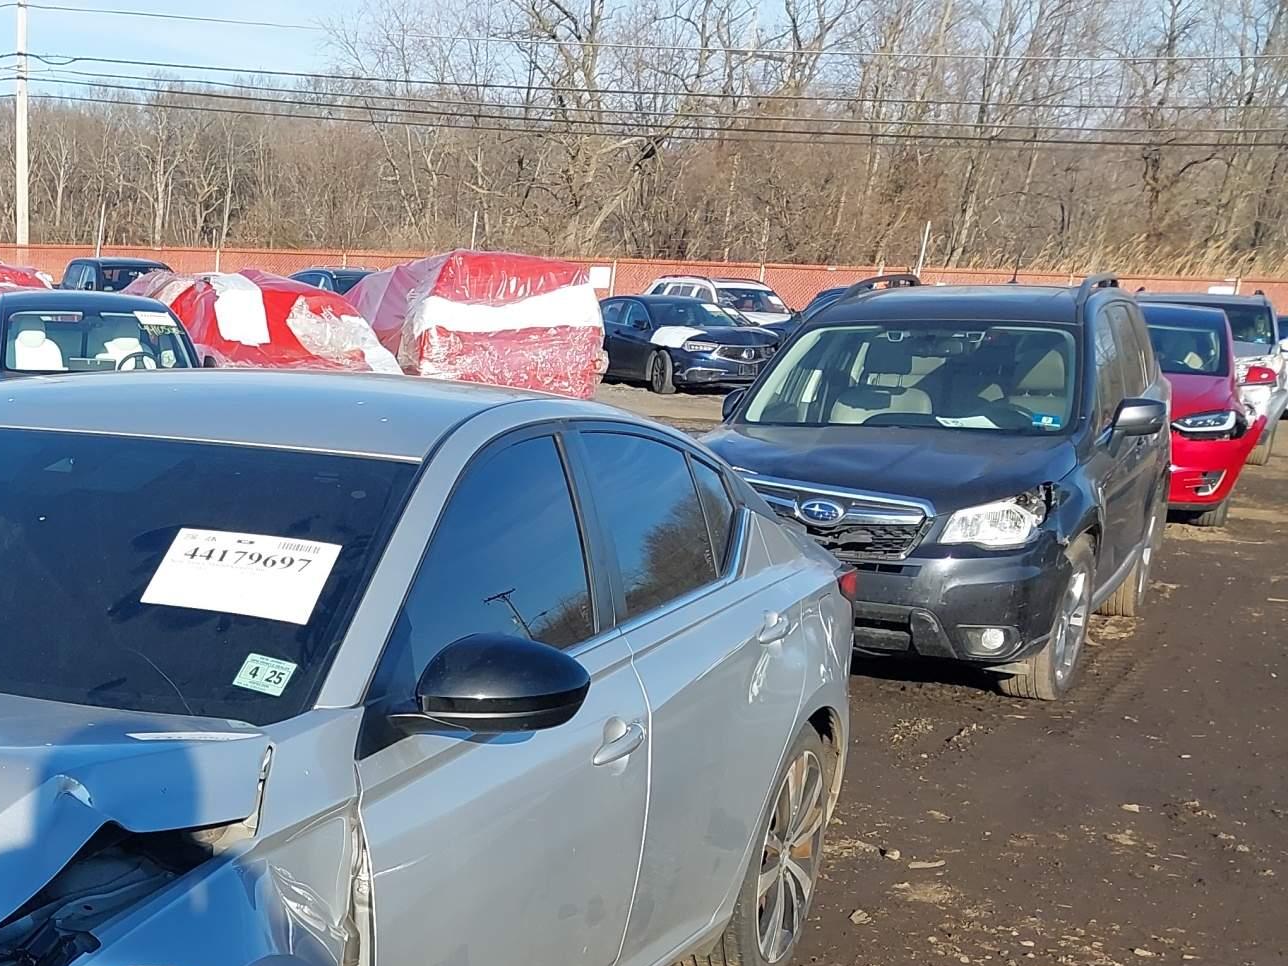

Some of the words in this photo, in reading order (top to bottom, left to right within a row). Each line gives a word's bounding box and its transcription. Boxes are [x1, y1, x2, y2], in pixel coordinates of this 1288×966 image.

[184, 546, 313, 573] 44179697
[249, 666, 260, 679] 4
[265, 670, 285, 685] 25
